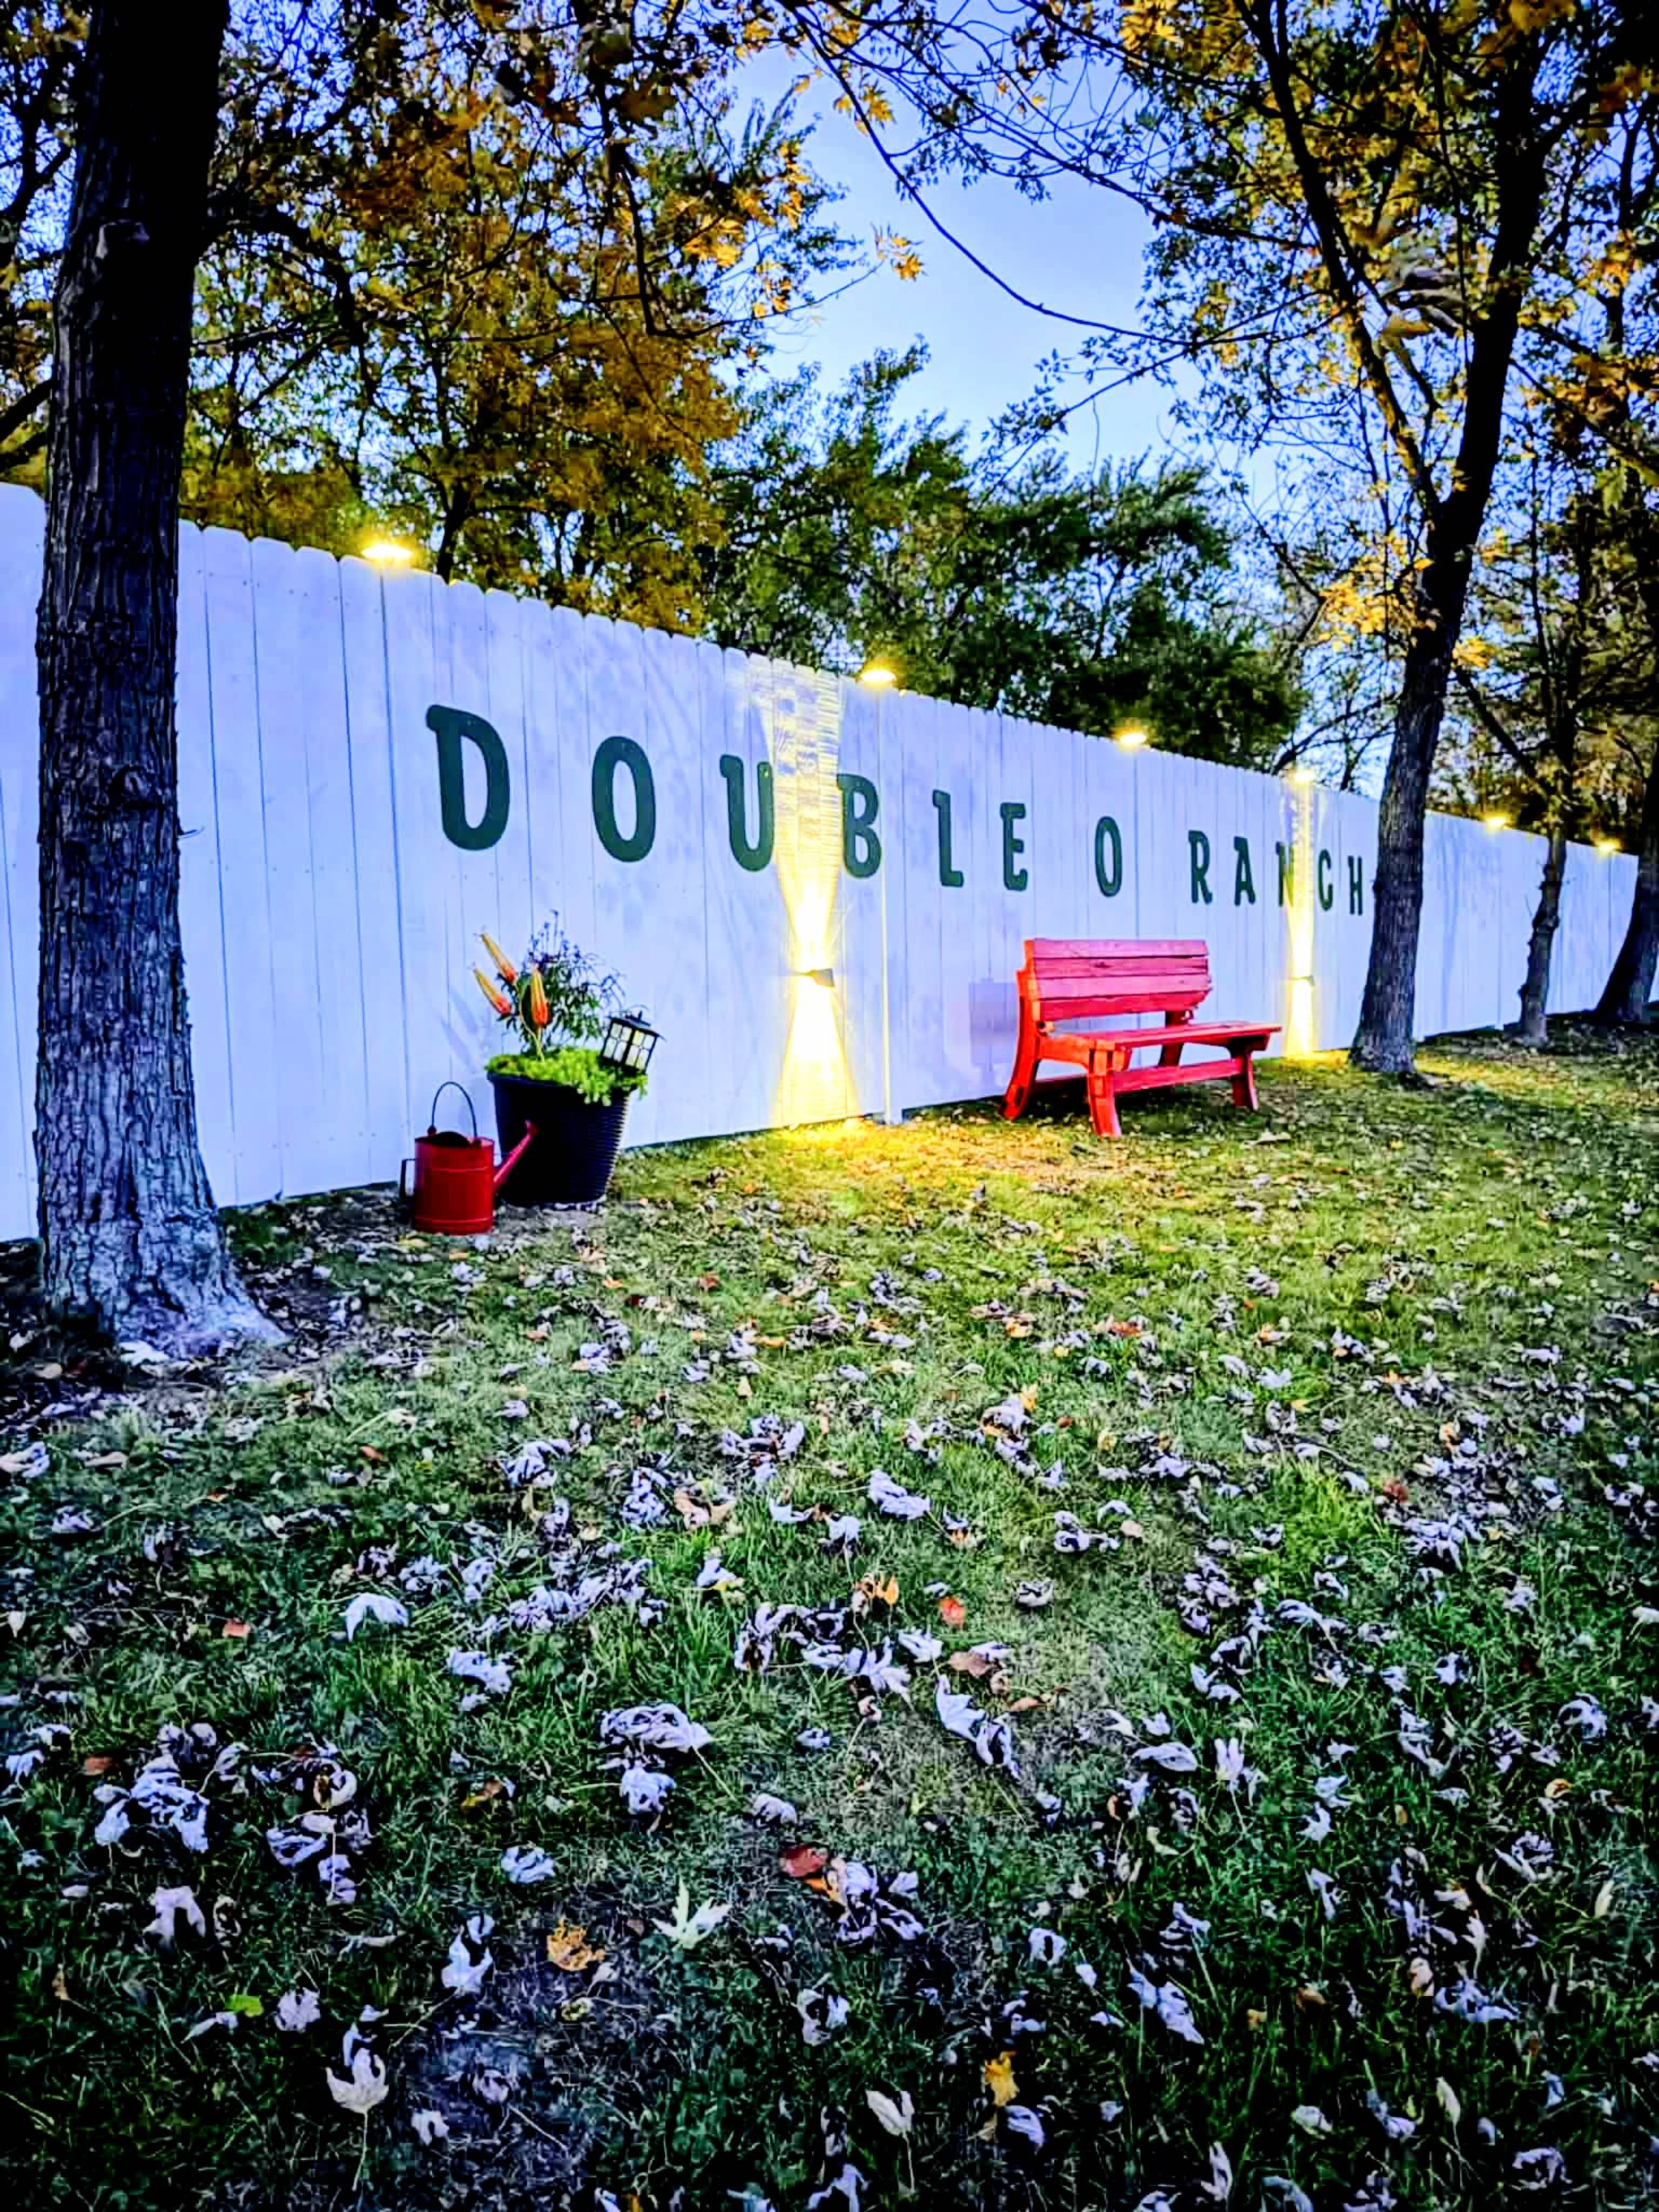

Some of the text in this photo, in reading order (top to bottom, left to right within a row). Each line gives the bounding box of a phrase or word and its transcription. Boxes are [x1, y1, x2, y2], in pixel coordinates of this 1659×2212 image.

[426, 704, 1363, 915] DOUBLE O RANCH
